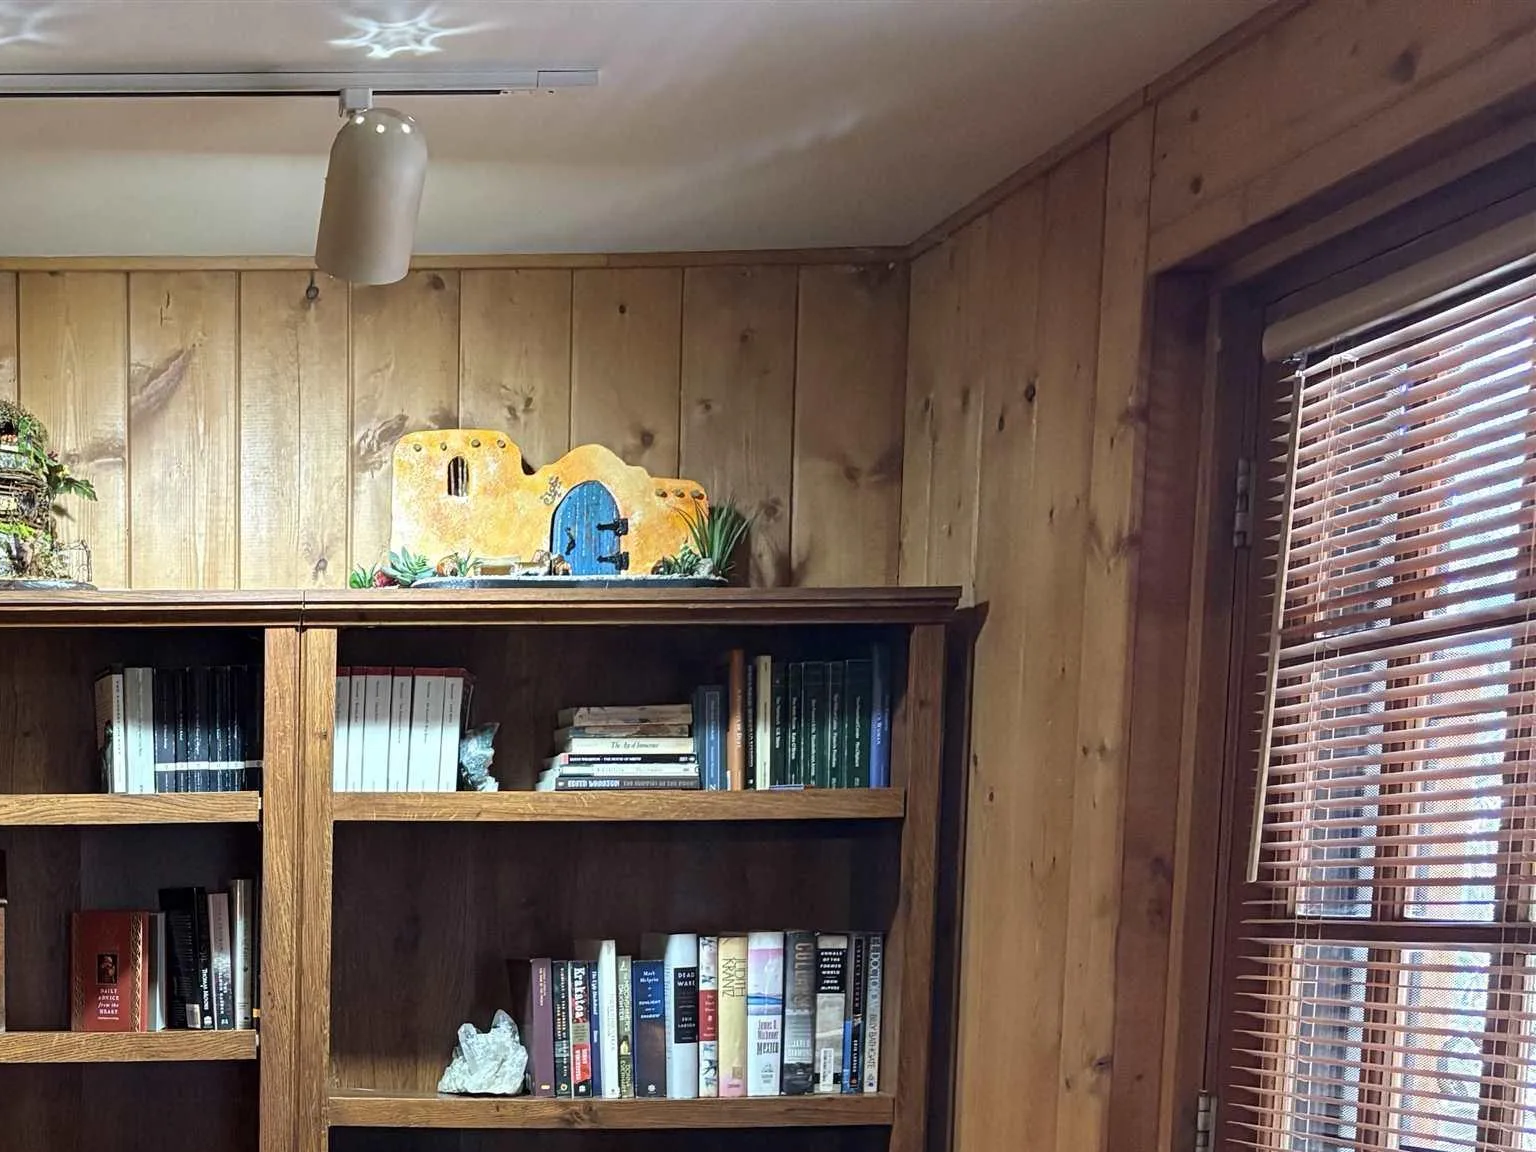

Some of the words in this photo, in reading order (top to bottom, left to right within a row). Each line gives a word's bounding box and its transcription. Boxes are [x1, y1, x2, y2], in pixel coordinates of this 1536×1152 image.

[573, 967, 586, 1018] Krakatoa
[722, 958, 735, 998] KRANTZ
[735, 959, 747, 997] JUDITH
[867, 1031, 876, 1070] BATHGATE
